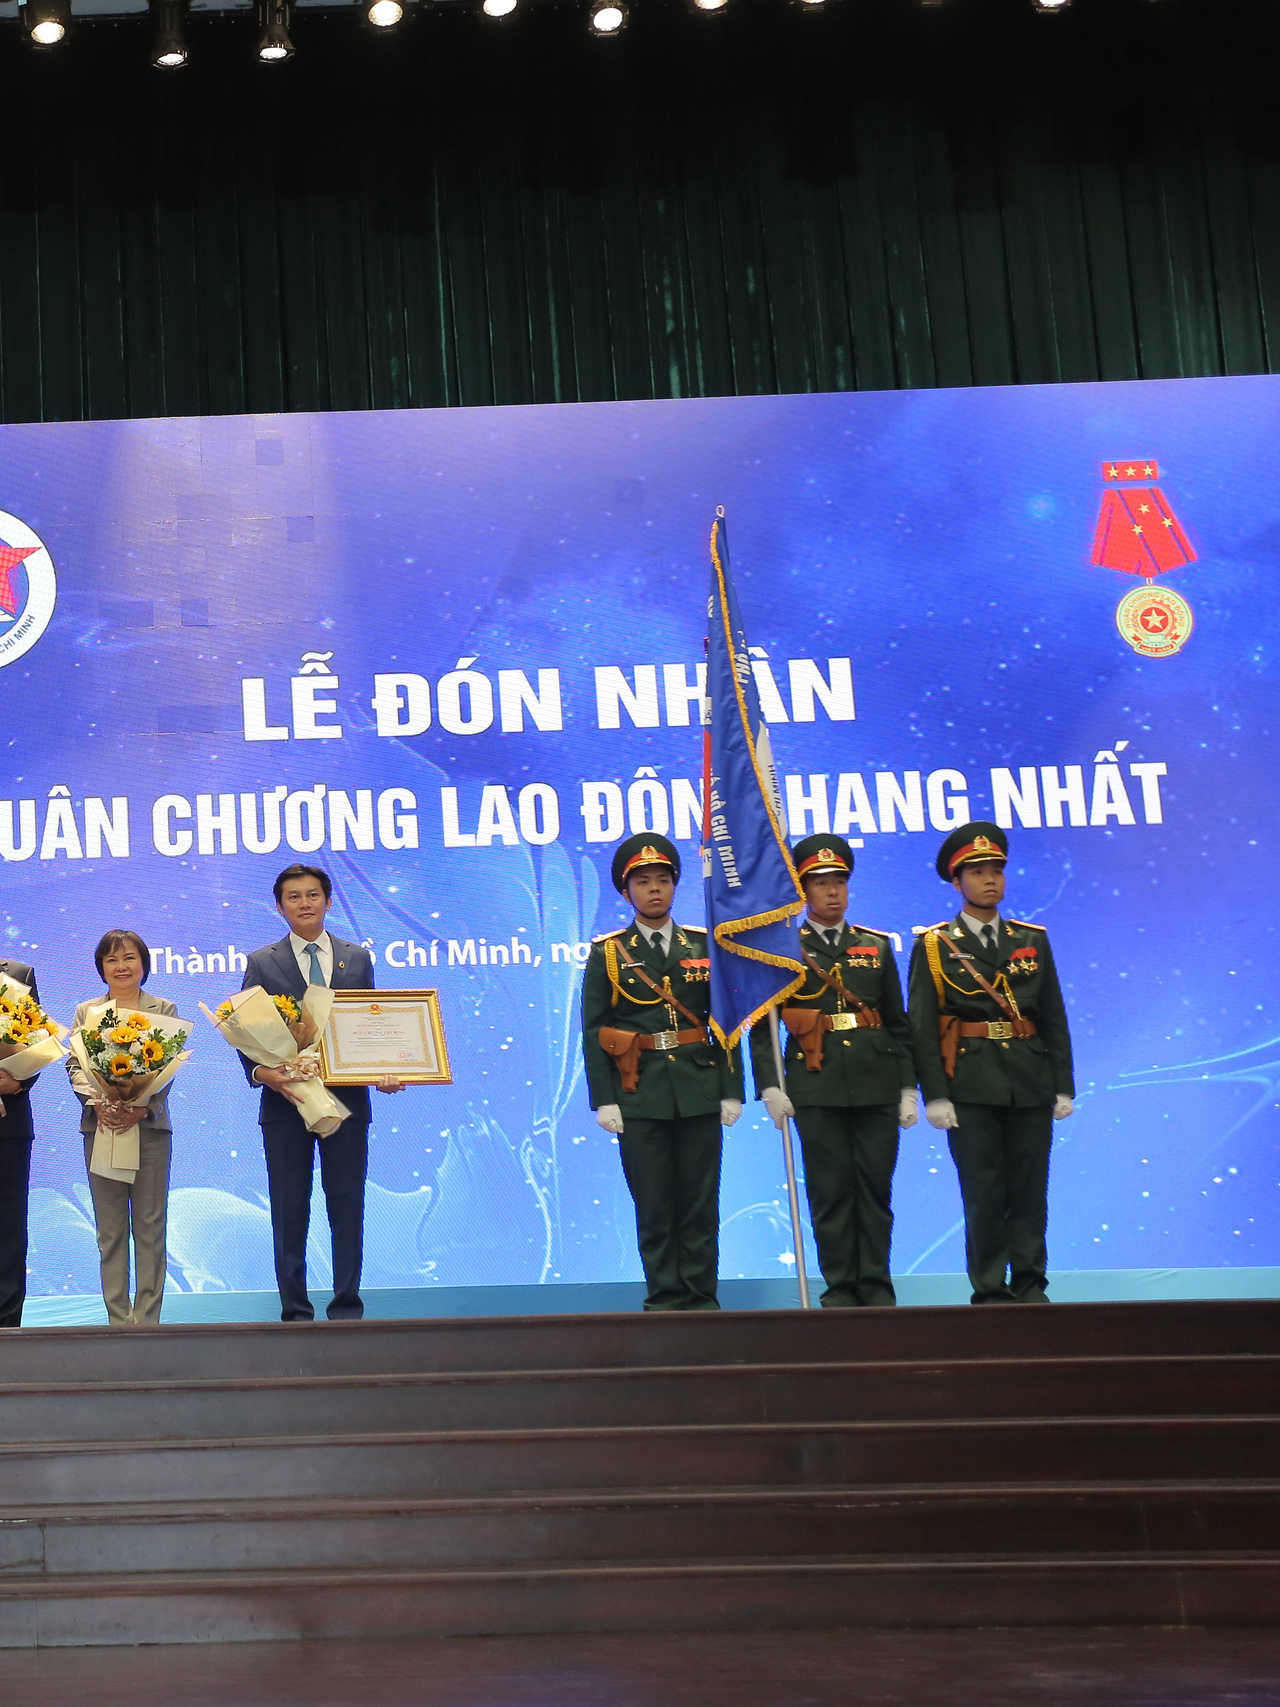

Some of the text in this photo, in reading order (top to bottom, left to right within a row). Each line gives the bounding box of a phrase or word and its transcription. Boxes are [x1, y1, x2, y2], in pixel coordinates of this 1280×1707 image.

[14, 615, 35, 640] MINH
[241, 651, 343, 742] LỄ
[371, 656, 563, 738] ĐÓN
[152, 783, 419, 857] CHƯƠNG
[440, 782, 560, 849] LAO
[785, 766, 969, 848] HẠNG
[990, 740, 1168, 829] NHẤT
[718, 845, 742, 888] MINH
[148, 945, 248, 975] Thành
[385, 939, 439, 967] Chí
[448, 937, 542, 968] Minh,
